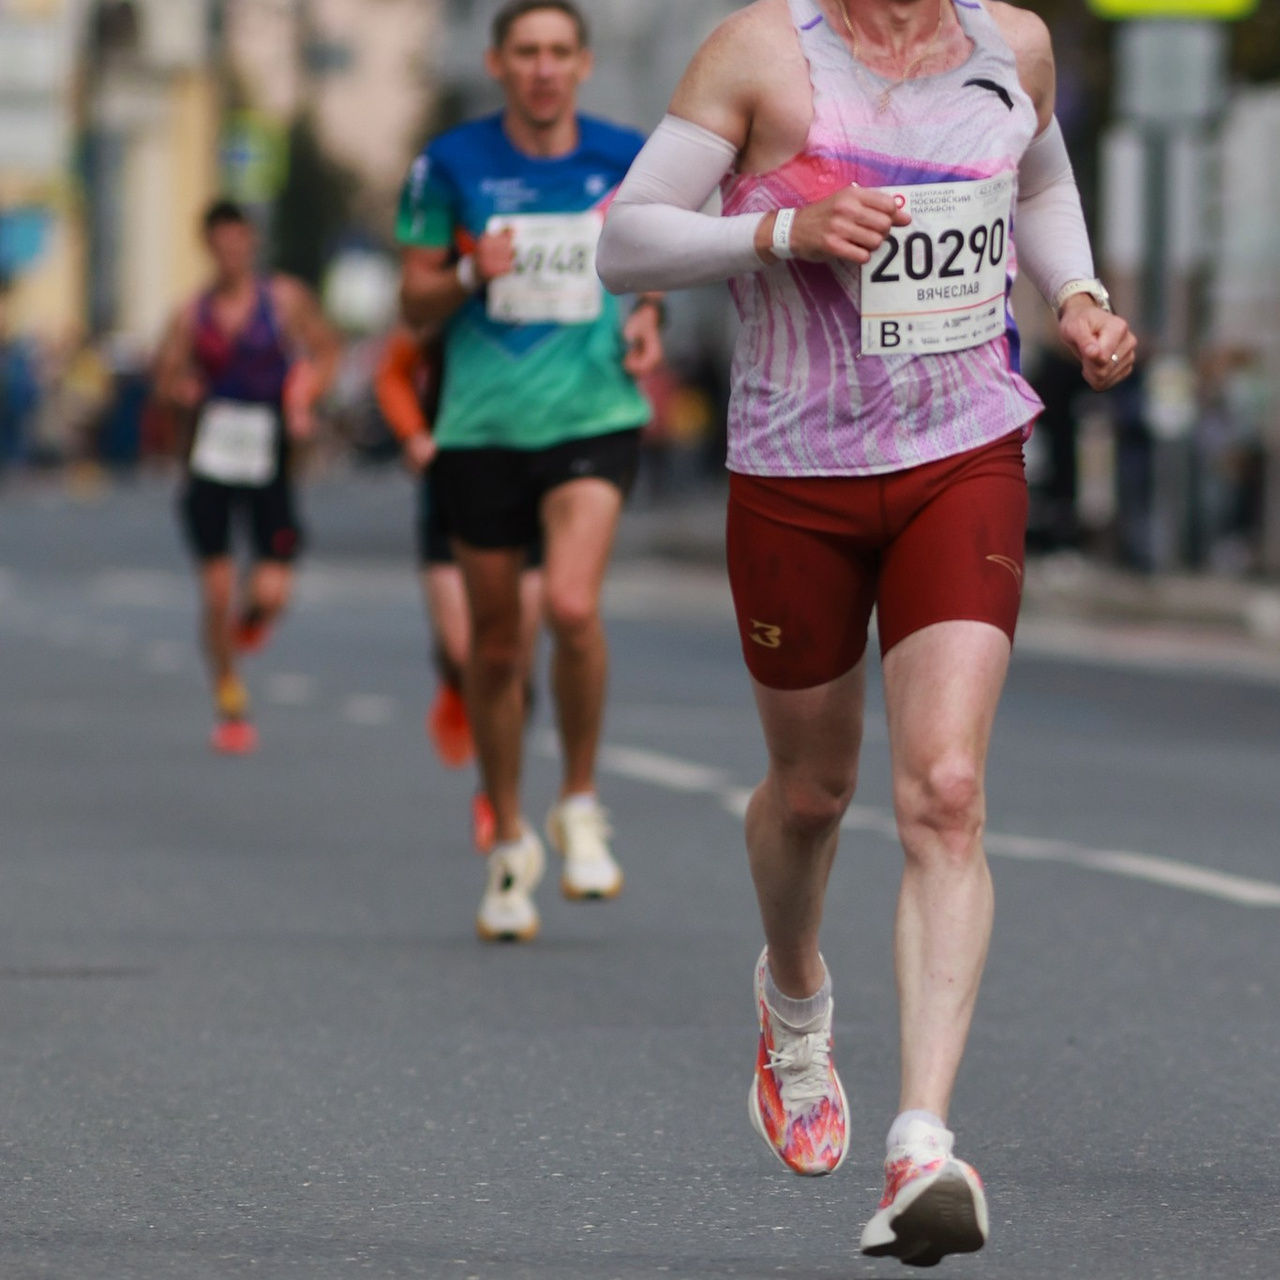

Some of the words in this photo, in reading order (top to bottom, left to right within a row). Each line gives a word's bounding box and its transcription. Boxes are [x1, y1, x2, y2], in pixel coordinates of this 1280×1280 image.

[910, 194, 971, 206] МОСКОВСКИЙ
[910, 205, 955, 214] МАРАФОН
[870, 217, 1005, 283] 20290
[917, 281, 980, 301] ВЯЧЕСЛАВ
